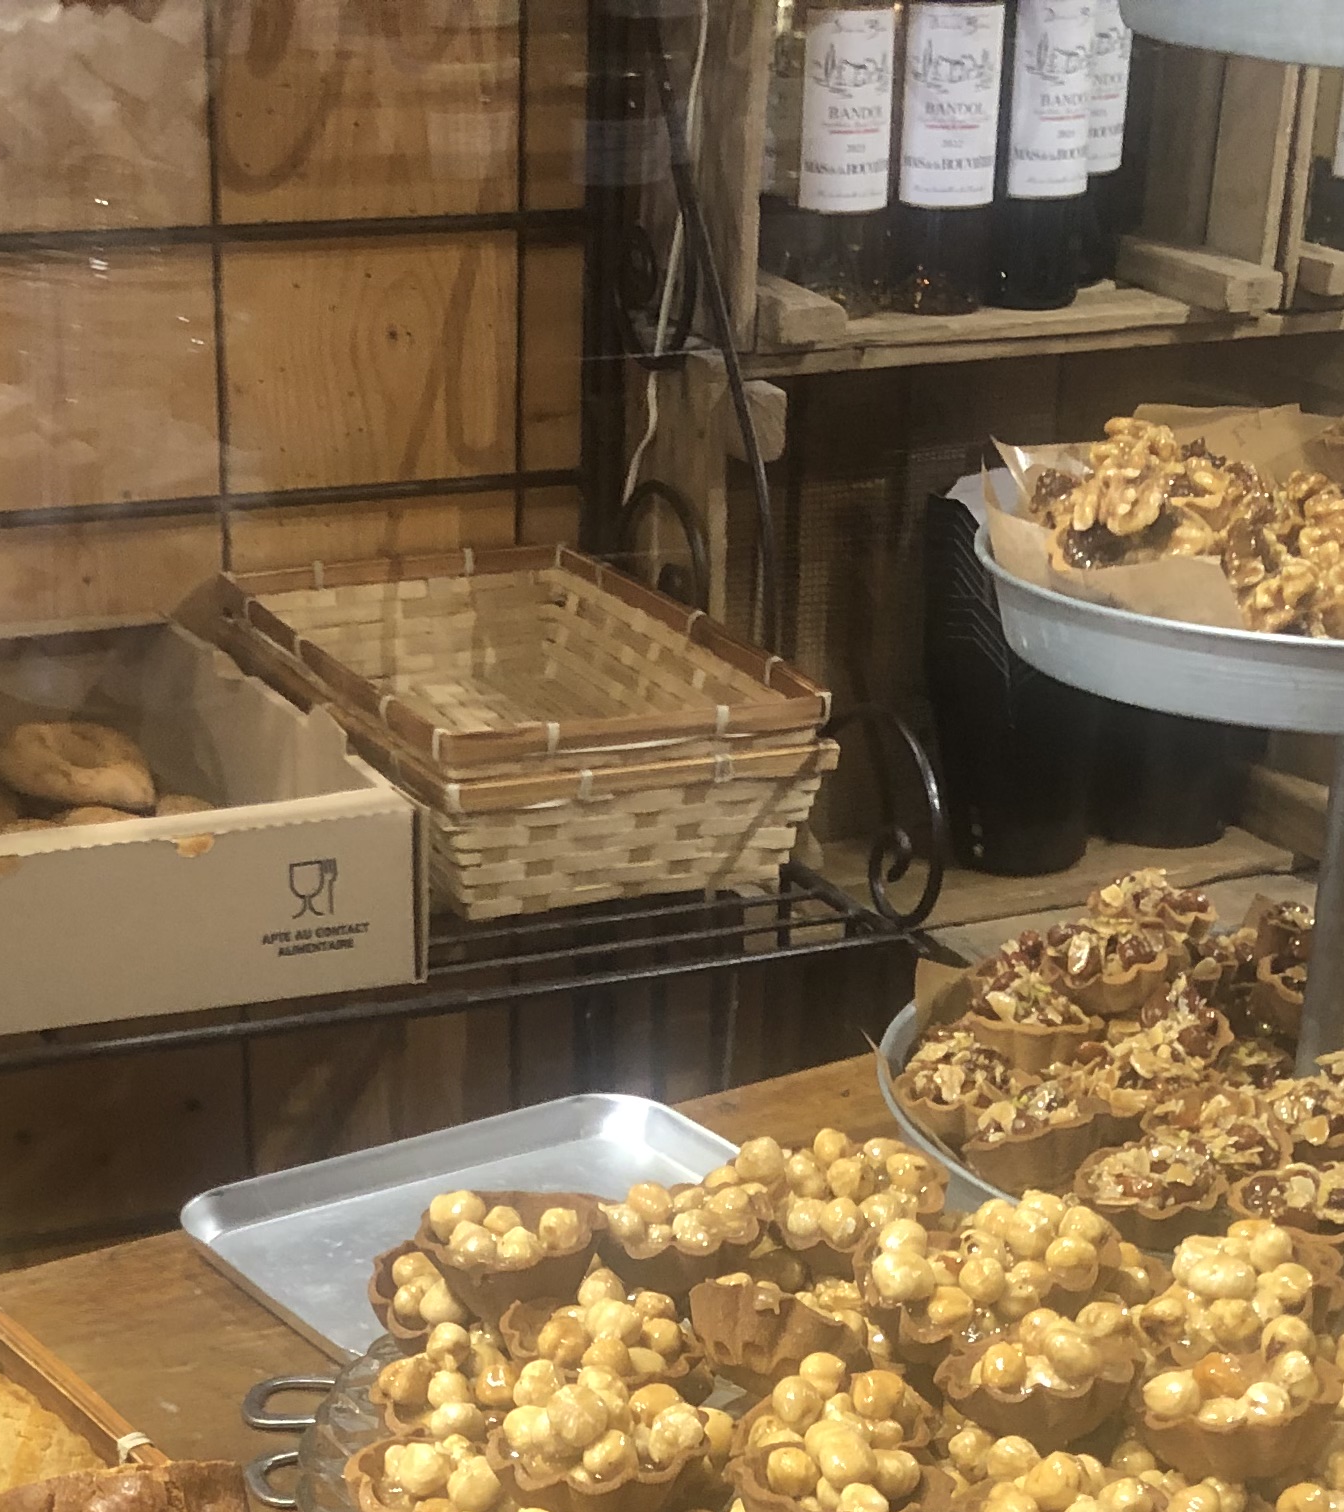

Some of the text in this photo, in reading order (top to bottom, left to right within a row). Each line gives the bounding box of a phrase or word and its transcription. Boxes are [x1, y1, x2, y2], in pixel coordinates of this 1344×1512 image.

[262, 922, 369, 945] APTE AU CONTACT
